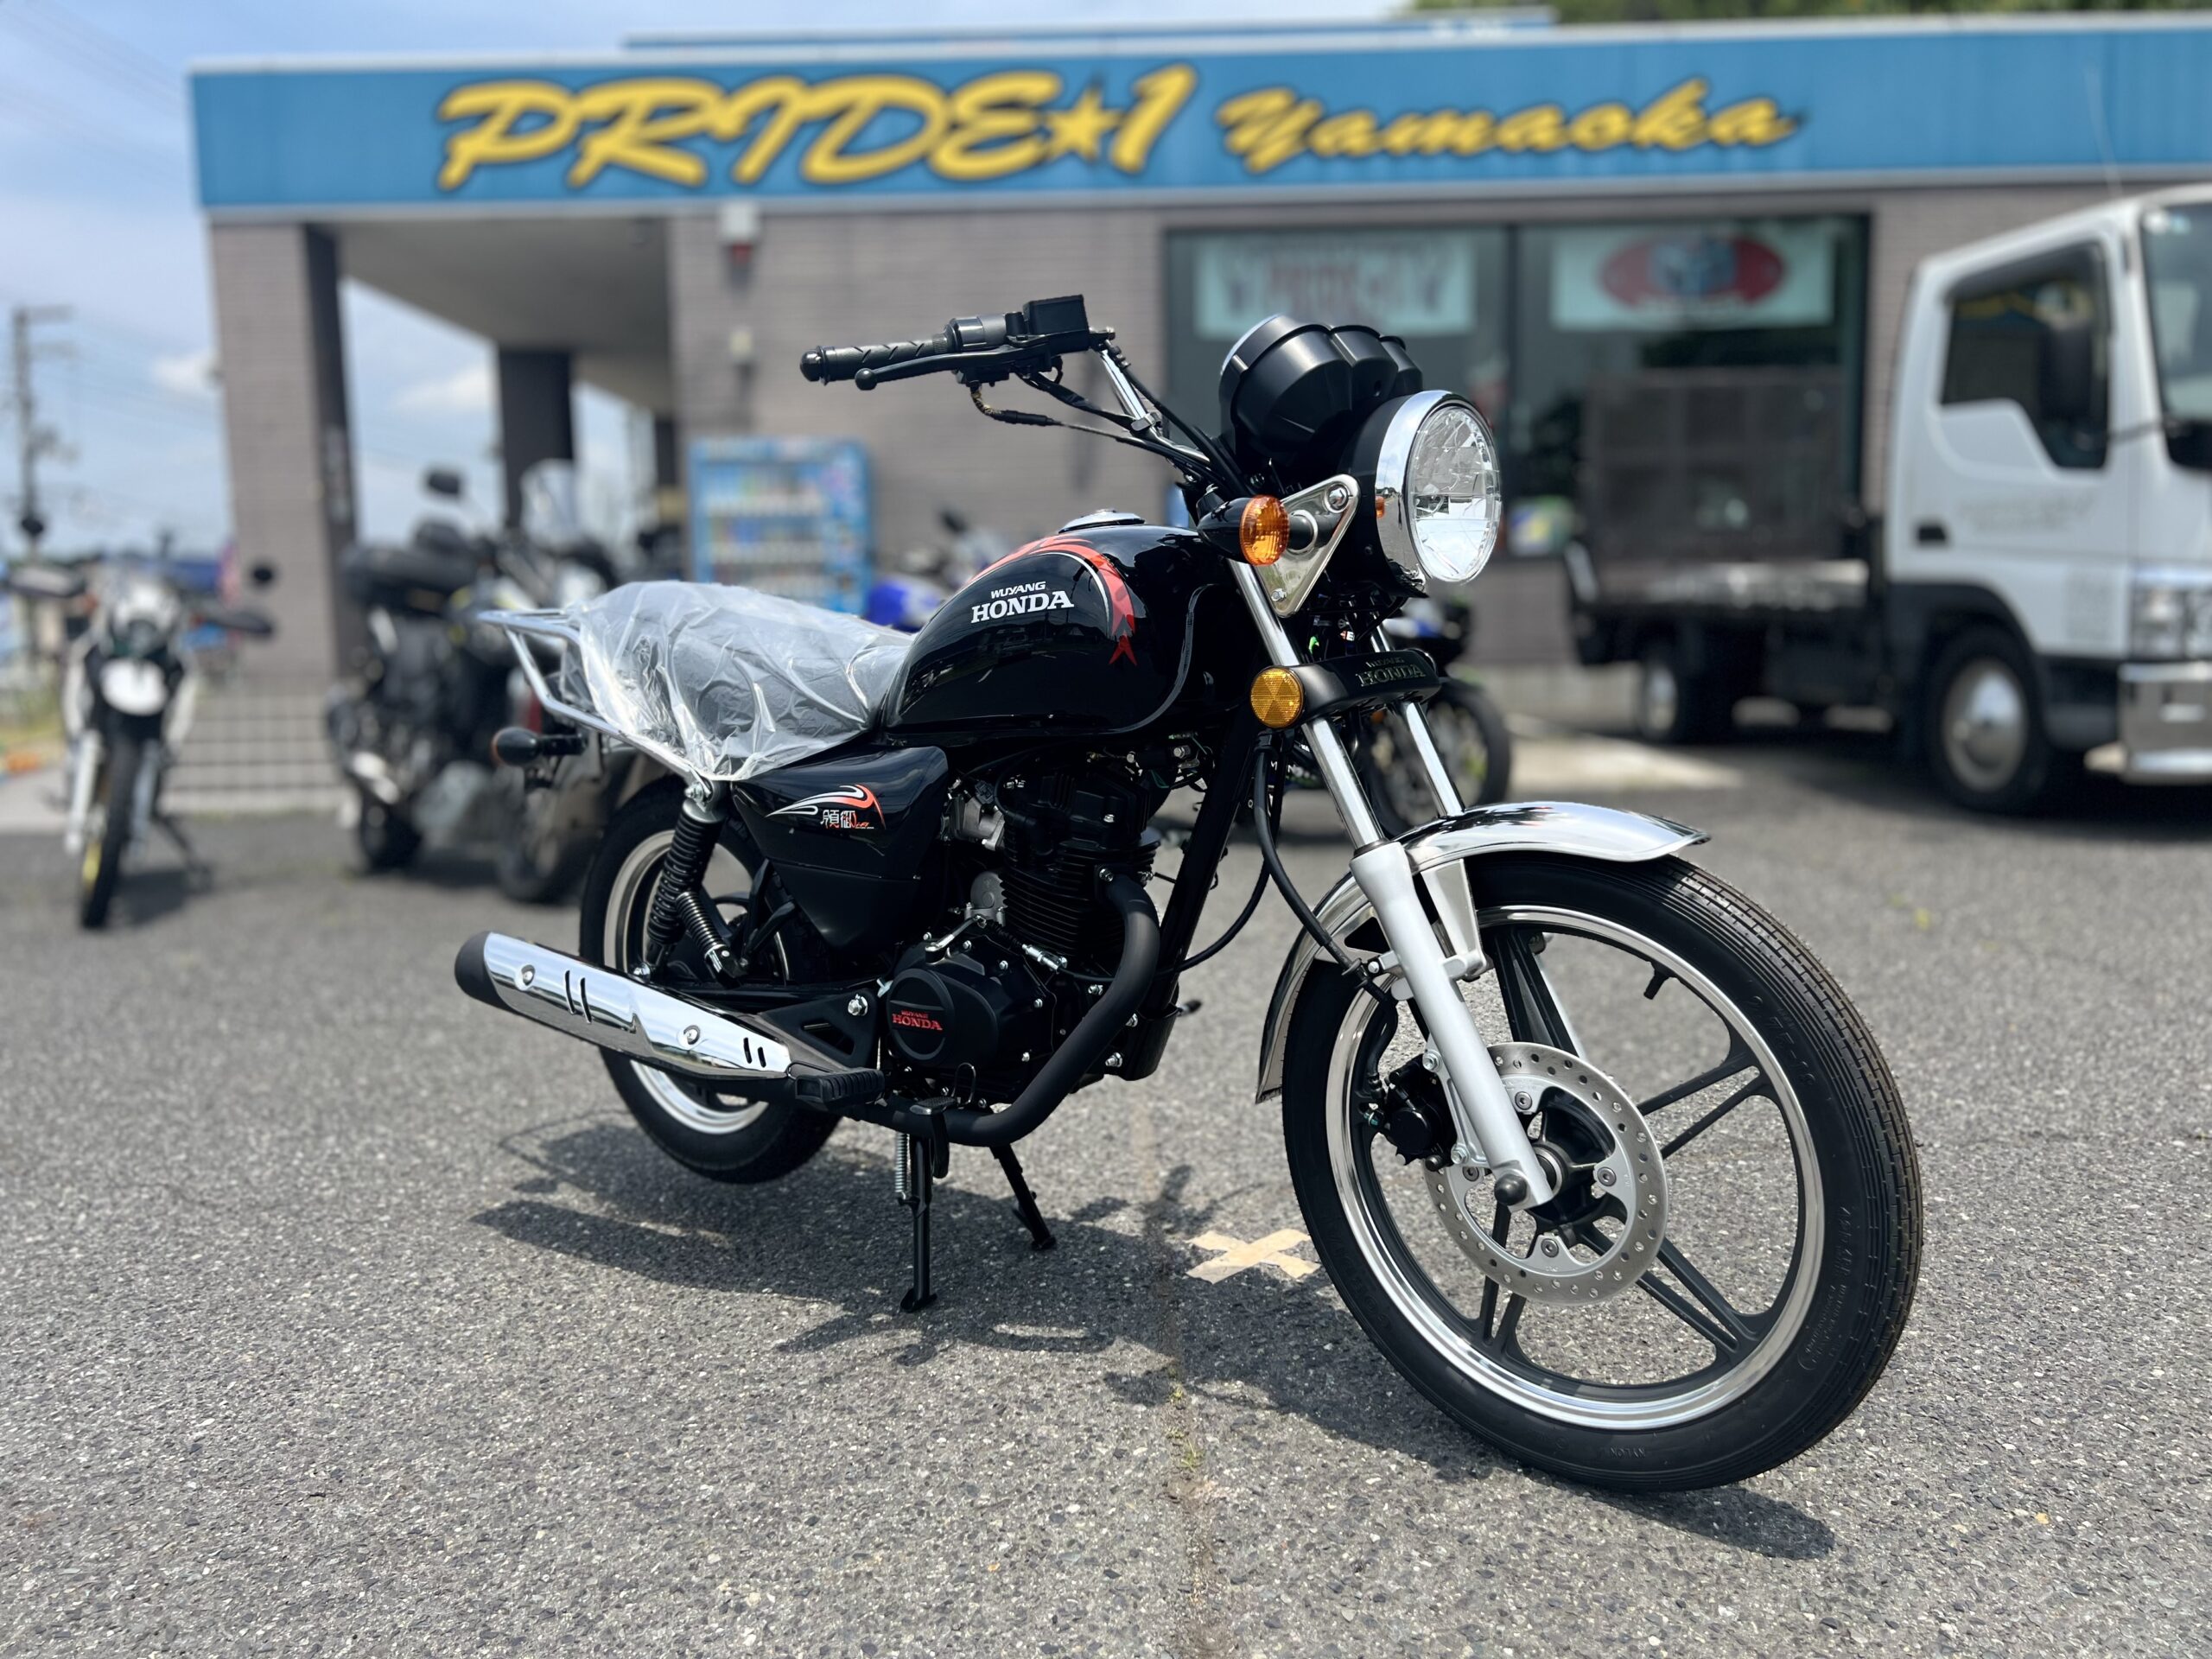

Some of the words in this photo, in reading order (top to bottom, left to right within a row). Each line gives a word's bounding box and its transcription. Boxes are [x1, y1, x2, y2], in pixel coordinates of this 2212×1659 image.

[438, 71, 1062, 191] PRIDE
[1217, 78, 1797, 174] Yamaoka
[991, 581, 1046, 599] WUYANG
[970, 590, 1074, 624] HONDA
[1355, 664, 1426, 687] HONDA
[892, 1013, 944, 1031] HONDA
